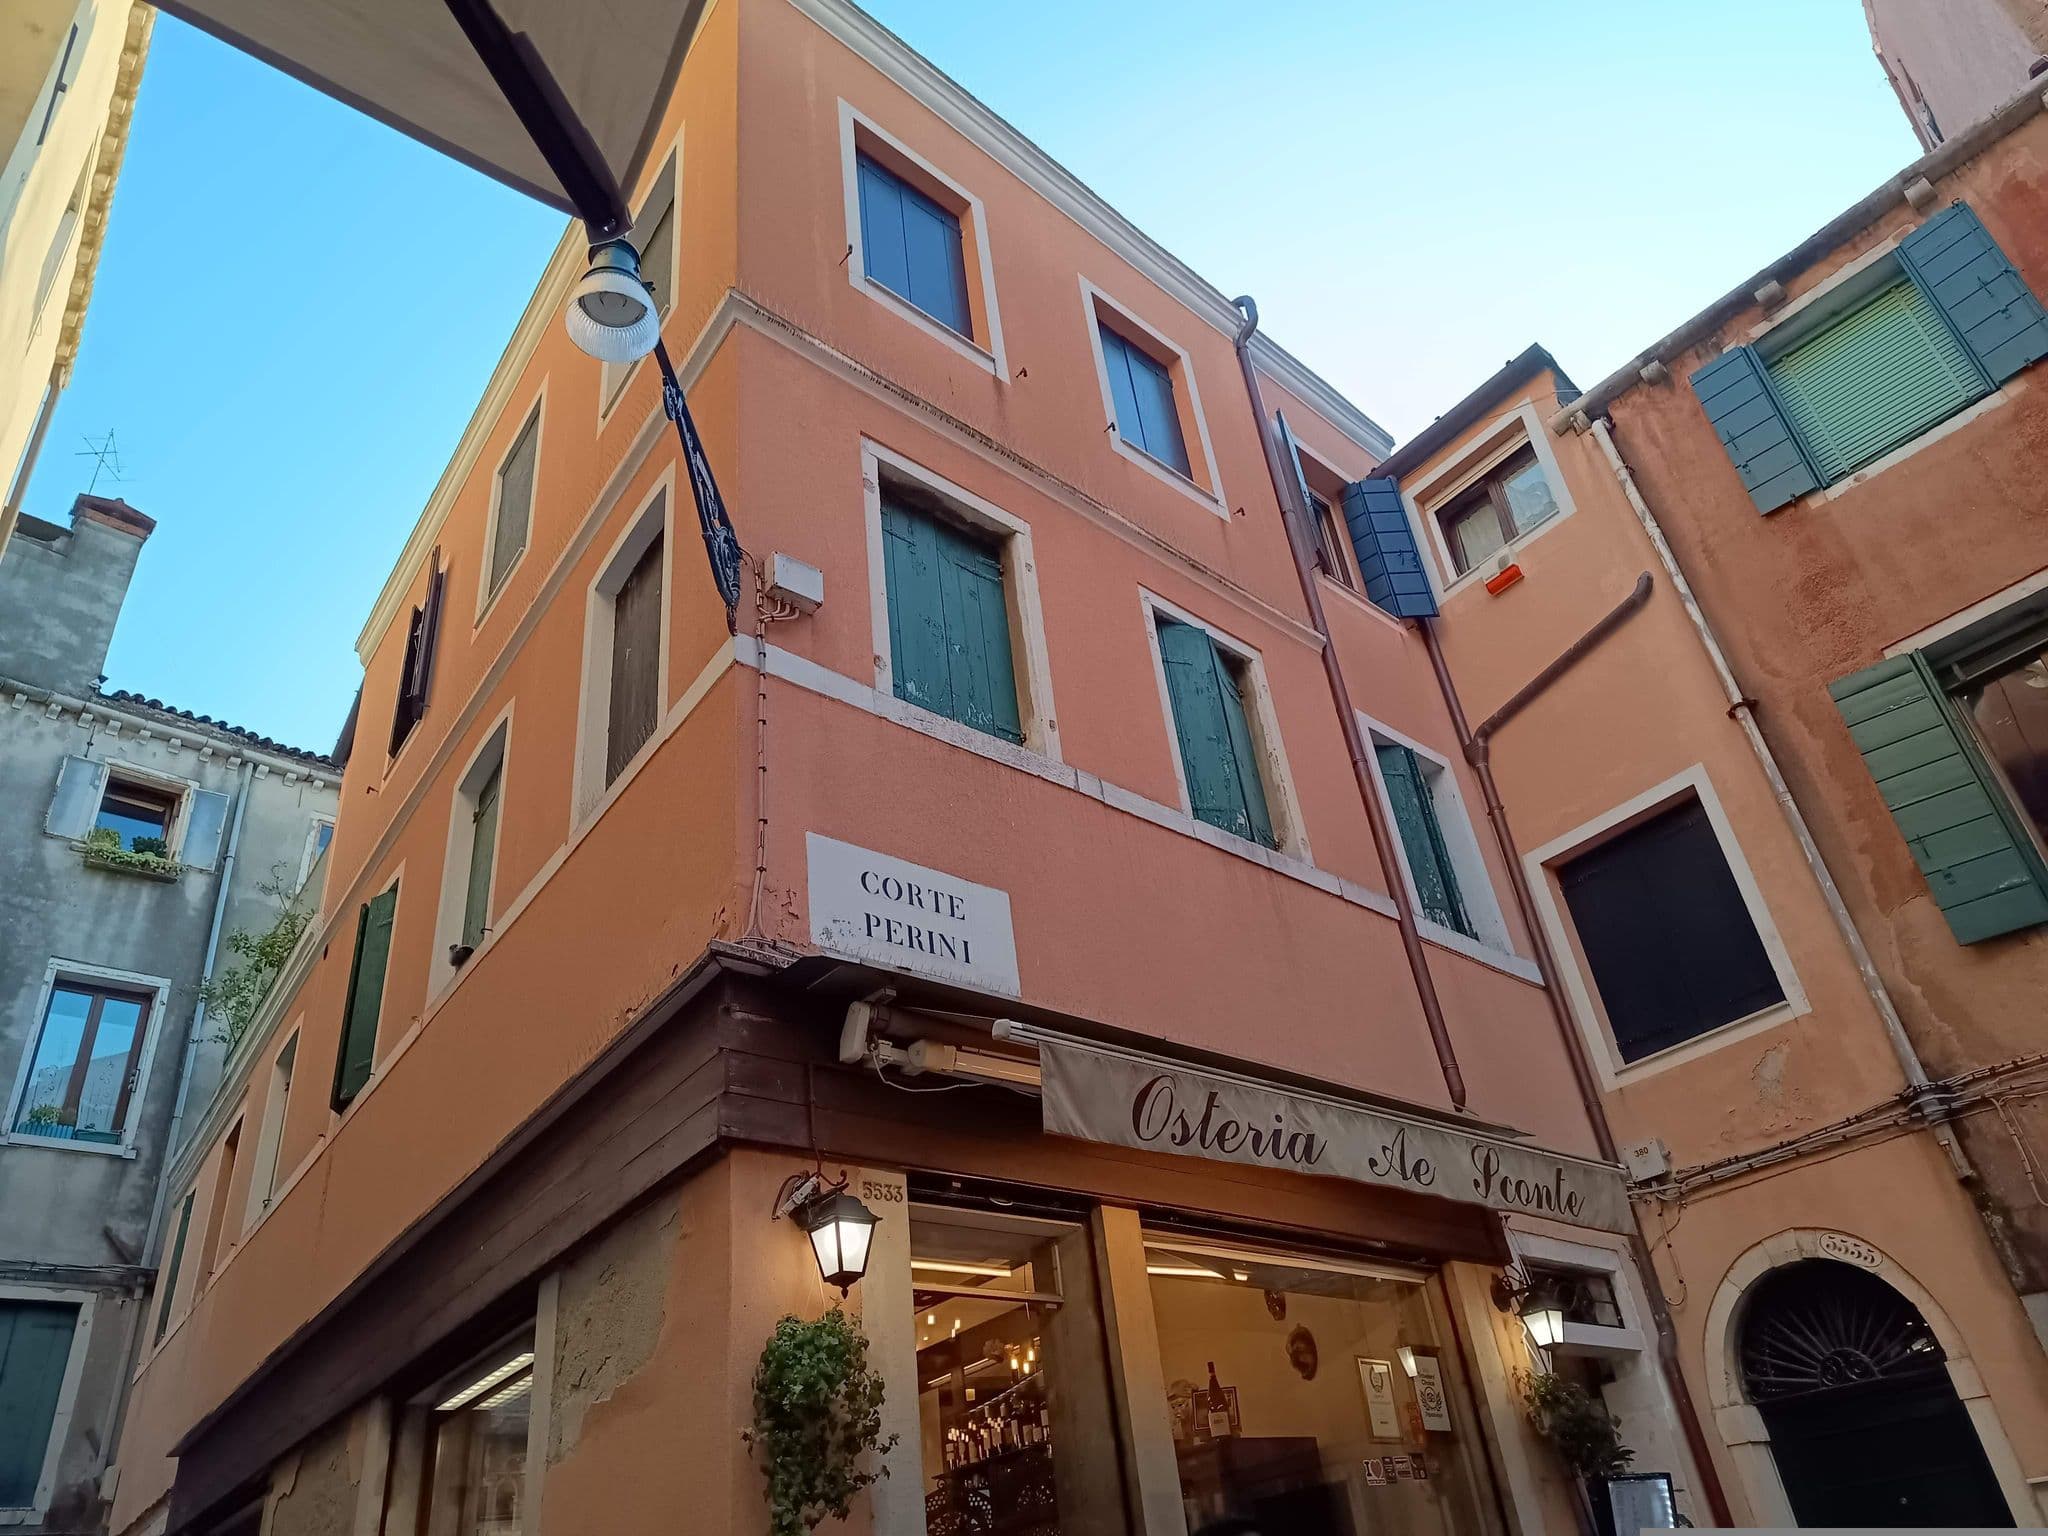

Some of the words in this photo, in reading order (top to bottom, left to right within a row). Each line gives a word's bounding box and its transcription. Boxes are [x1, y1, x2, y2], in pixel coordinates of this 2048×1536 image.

[860, 870, 966, 920] CORTE
[864, 912, 972, 964] PERINI
[1131, 1074, 1328, 1166] Osteria
[1368, 1127, 1436, 1186] Ae
[1471, 1144, 1586, 1217] Sconte
[862, 1180, 904, 1203] 5533
